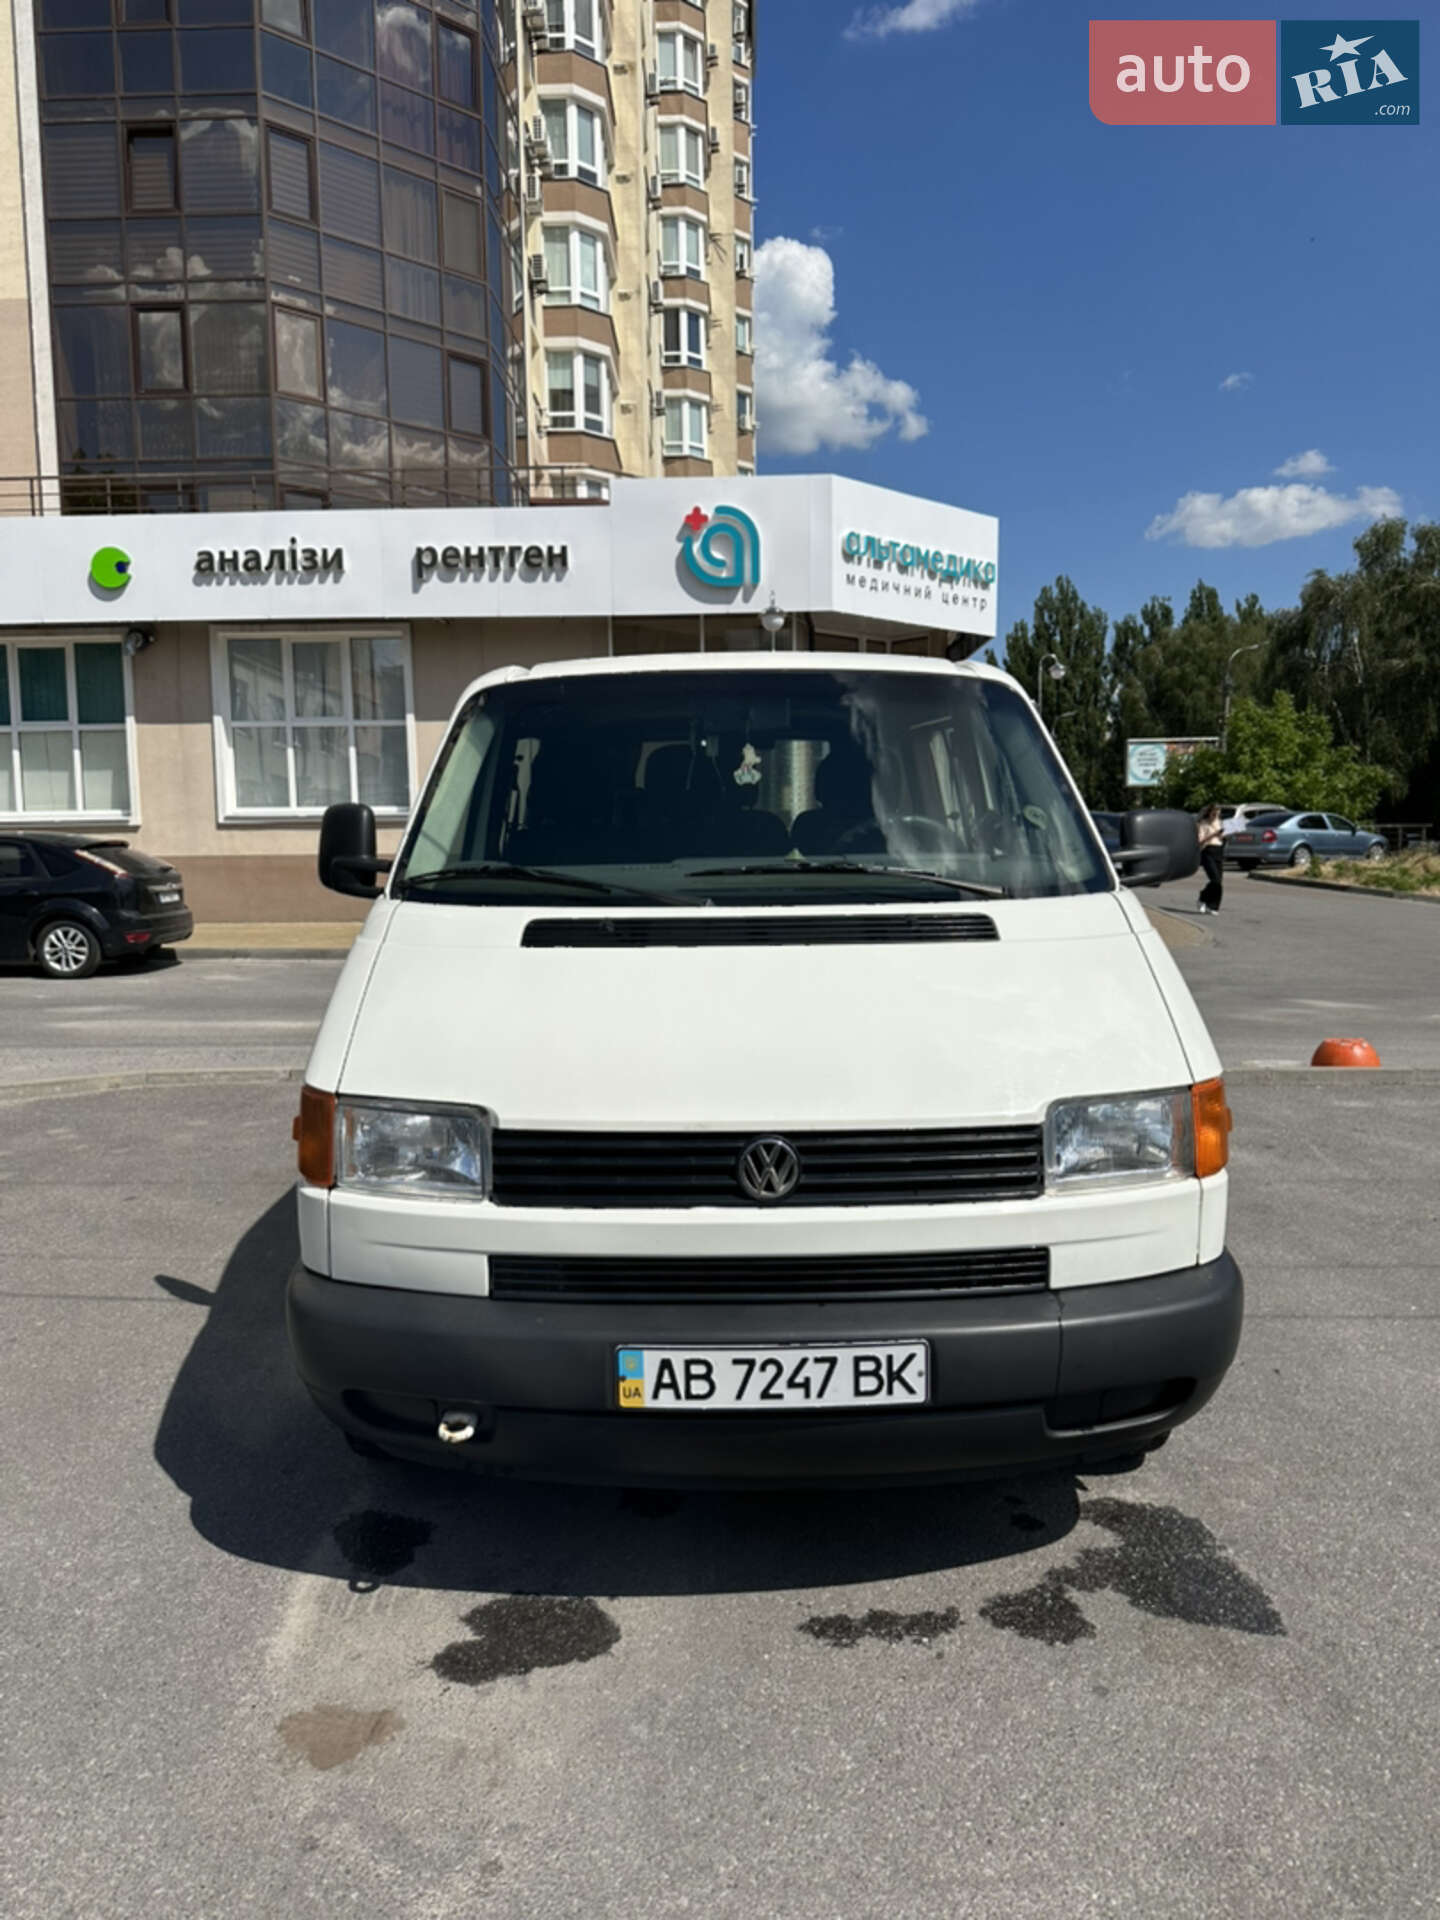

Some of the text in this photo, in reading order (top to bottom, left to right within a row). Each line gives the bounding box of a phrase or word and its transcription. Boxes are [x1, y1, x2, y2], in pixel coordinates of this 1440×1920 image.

[194, 536, 345, 573] аналізи
[414, 544, 569, 579] рентген
[845, 530, 997, 585] альтамедика
[846, 573, 988, 612] медичний центр
[622, 1382, 642, 1399] UA
[651, 1353, 917, 1400] AB 7247 BK
